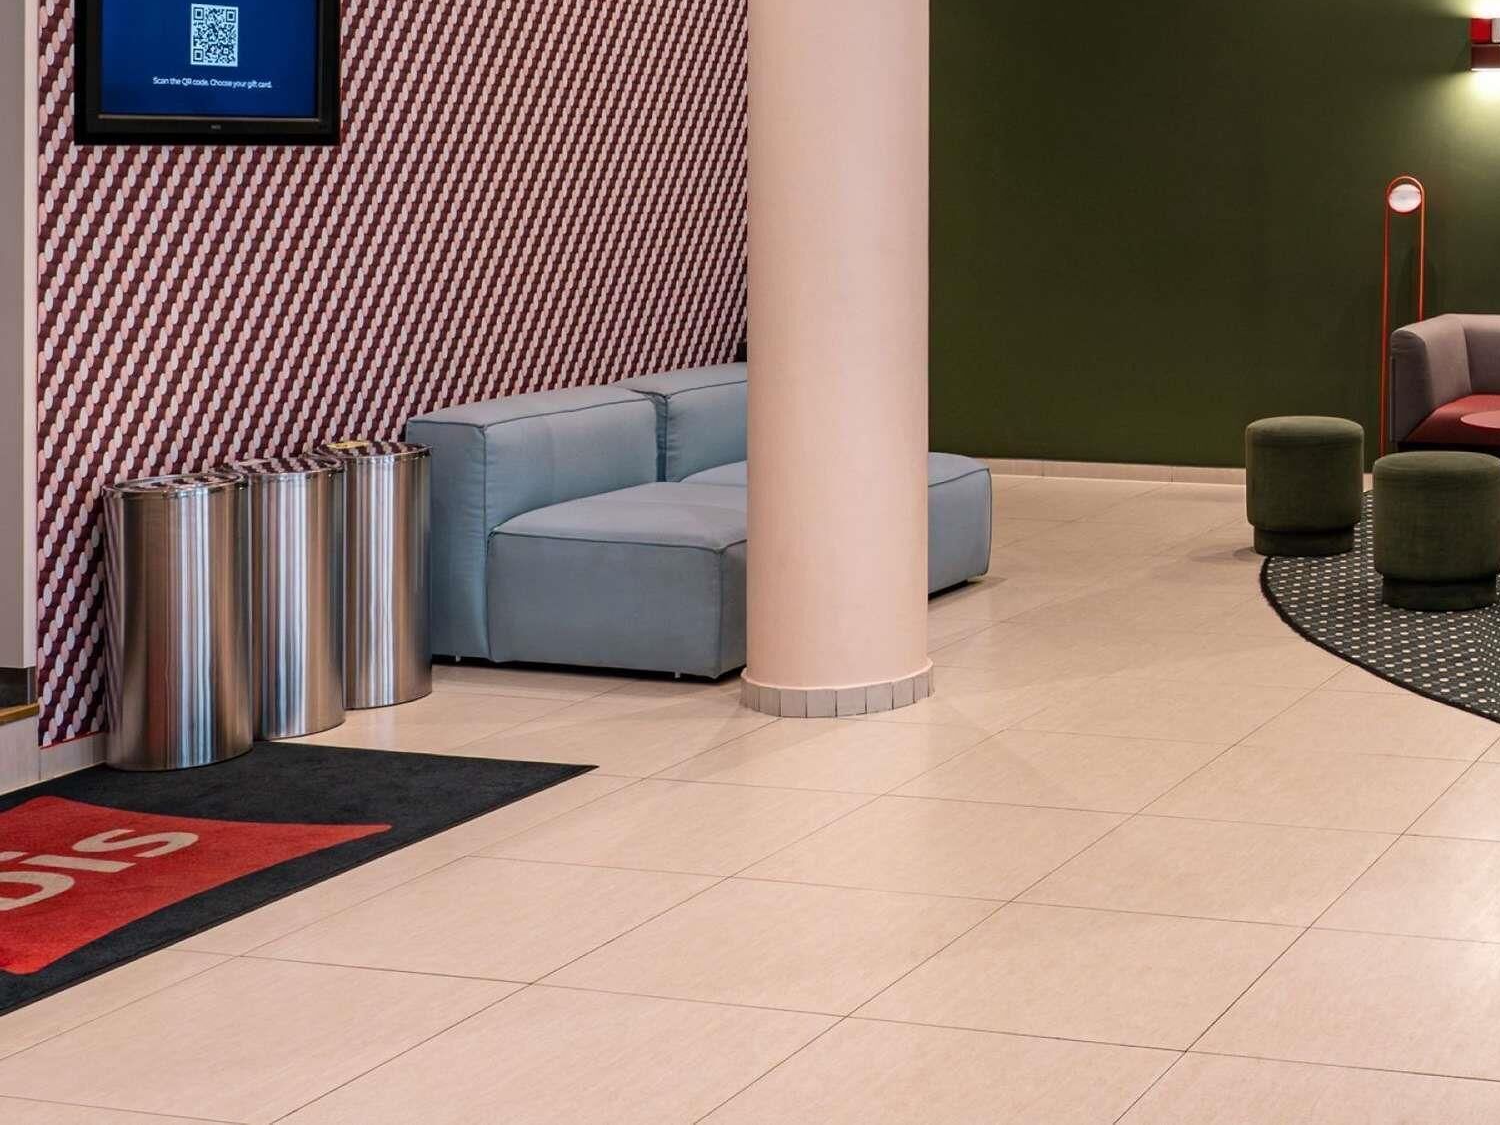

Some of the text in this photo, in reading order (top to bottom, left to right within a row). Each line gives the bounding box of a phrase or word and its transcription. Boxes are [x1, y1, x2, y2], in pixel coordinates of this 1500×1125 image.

[152, 76, 272, 90] Scan the QR code. Choose your gift card.
